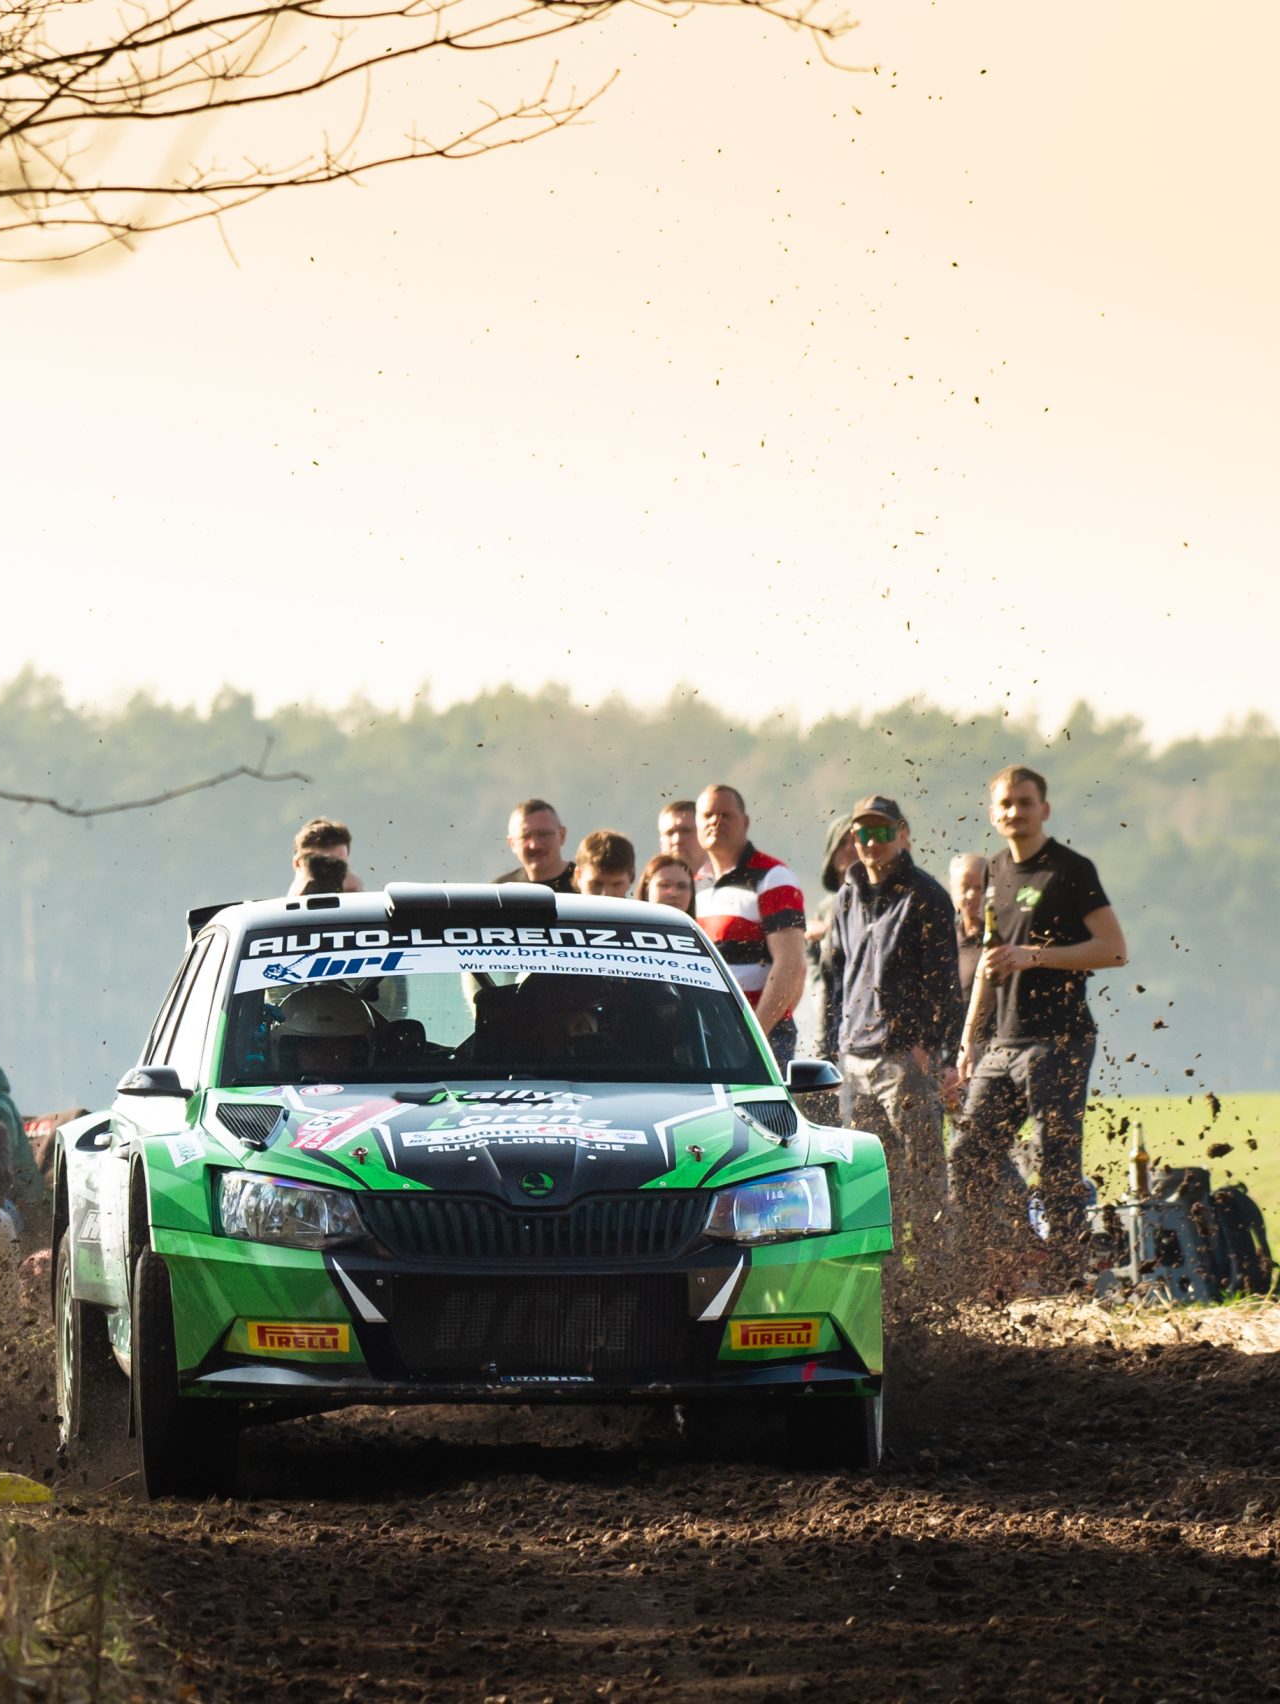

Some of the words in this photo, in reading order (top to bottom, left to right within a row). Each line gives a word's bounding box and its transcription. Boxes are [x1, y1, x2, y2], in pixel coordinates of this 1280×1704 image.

[249, 928, 701, 956] AUTO-LORENZ.DE
[307, 951, 421, 979] brt
[457, 948, 712, 974] www.brt-automotive.de
[489, 962, 548, 972] machen
[552, 964, 593, 973] Ihrem
[598, 967, 666, 980] Fahrwerk
[670, 974, 715, 988] Beine.
[427, 1089, 593, 1104] Rallye
[448, 1101, 582, 1114] Team
[427, 1114, 613, 1130] Lorenz
[427, 1137, 626, 1153] AUTO-LORENZ.DE
[257, 1325, 339, 1349] PIRELLI
[741, 1322, 813, 1346] PIRELLI
